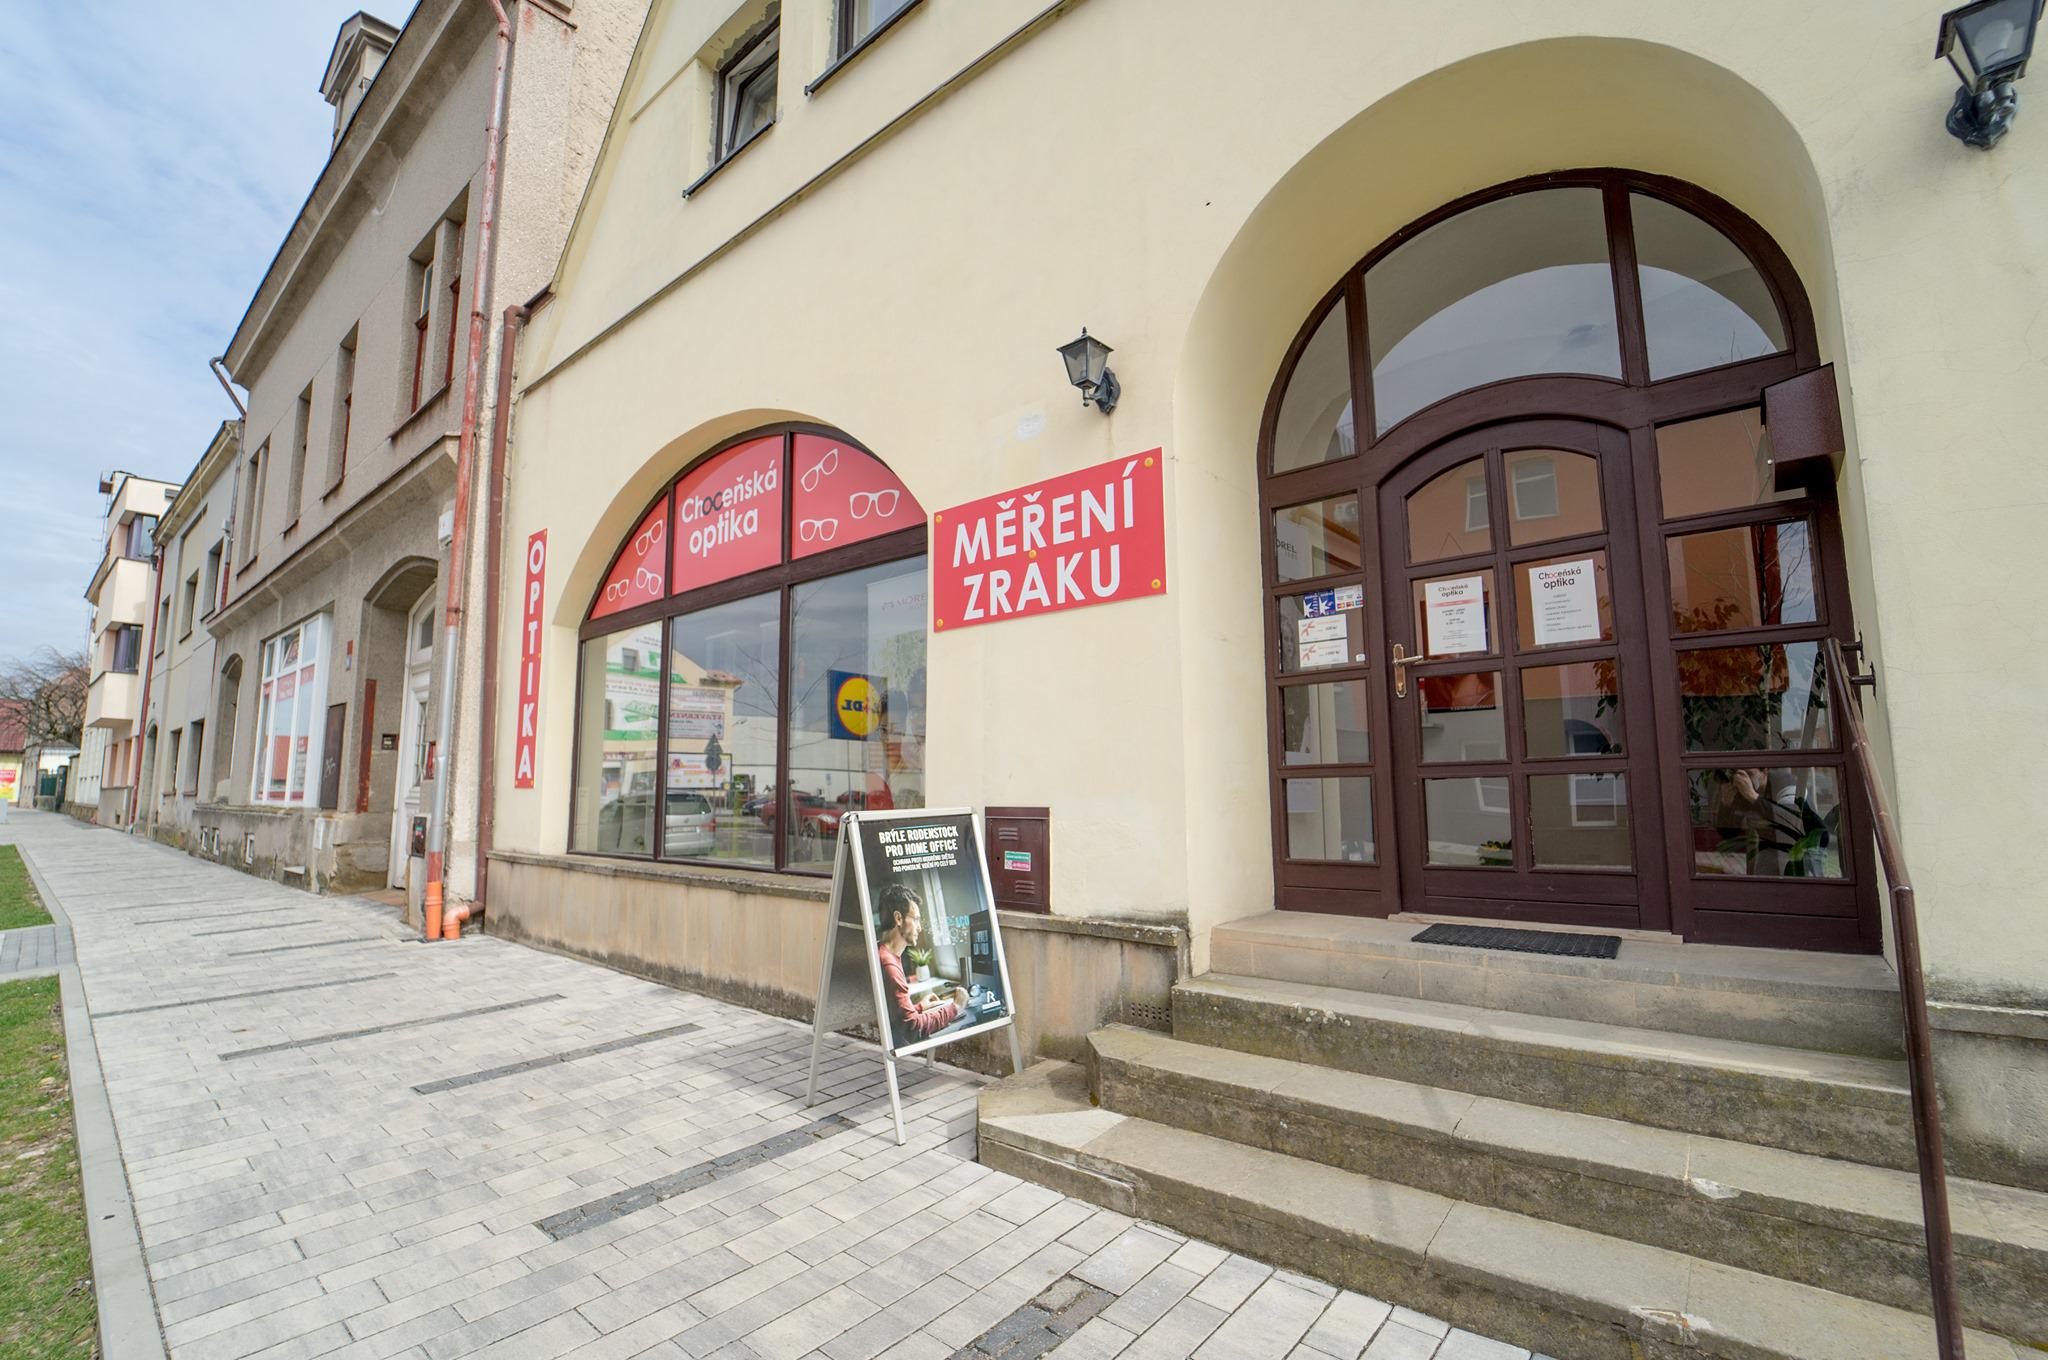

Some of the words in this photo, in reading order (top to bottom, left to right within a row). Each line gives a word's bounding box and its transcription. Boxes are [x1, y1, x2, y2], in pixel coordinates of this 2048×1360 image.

[682, 460, 777, 523] Choceňská
[952, 460, 1138, 568] MĚŘENÍ
[689, 508, 758, 557] optika
[963, 544, 1120, 621] ZRAKU
[1538, 566, 1582, 580] Choceňská
[1544, 578, 1575, 590] optika
[1441, 590, 1464, 598] optika
[517, 540, 544, 780] OPTIKA
[878, 828, 906, 844] BRÝLE
[907, 826, 958, 842] RODENSTOCK
[885, 844, 904, 858] PRO
[904, 842, 928, 855] HOME
[929, 839, 958, 852] OFFICE
